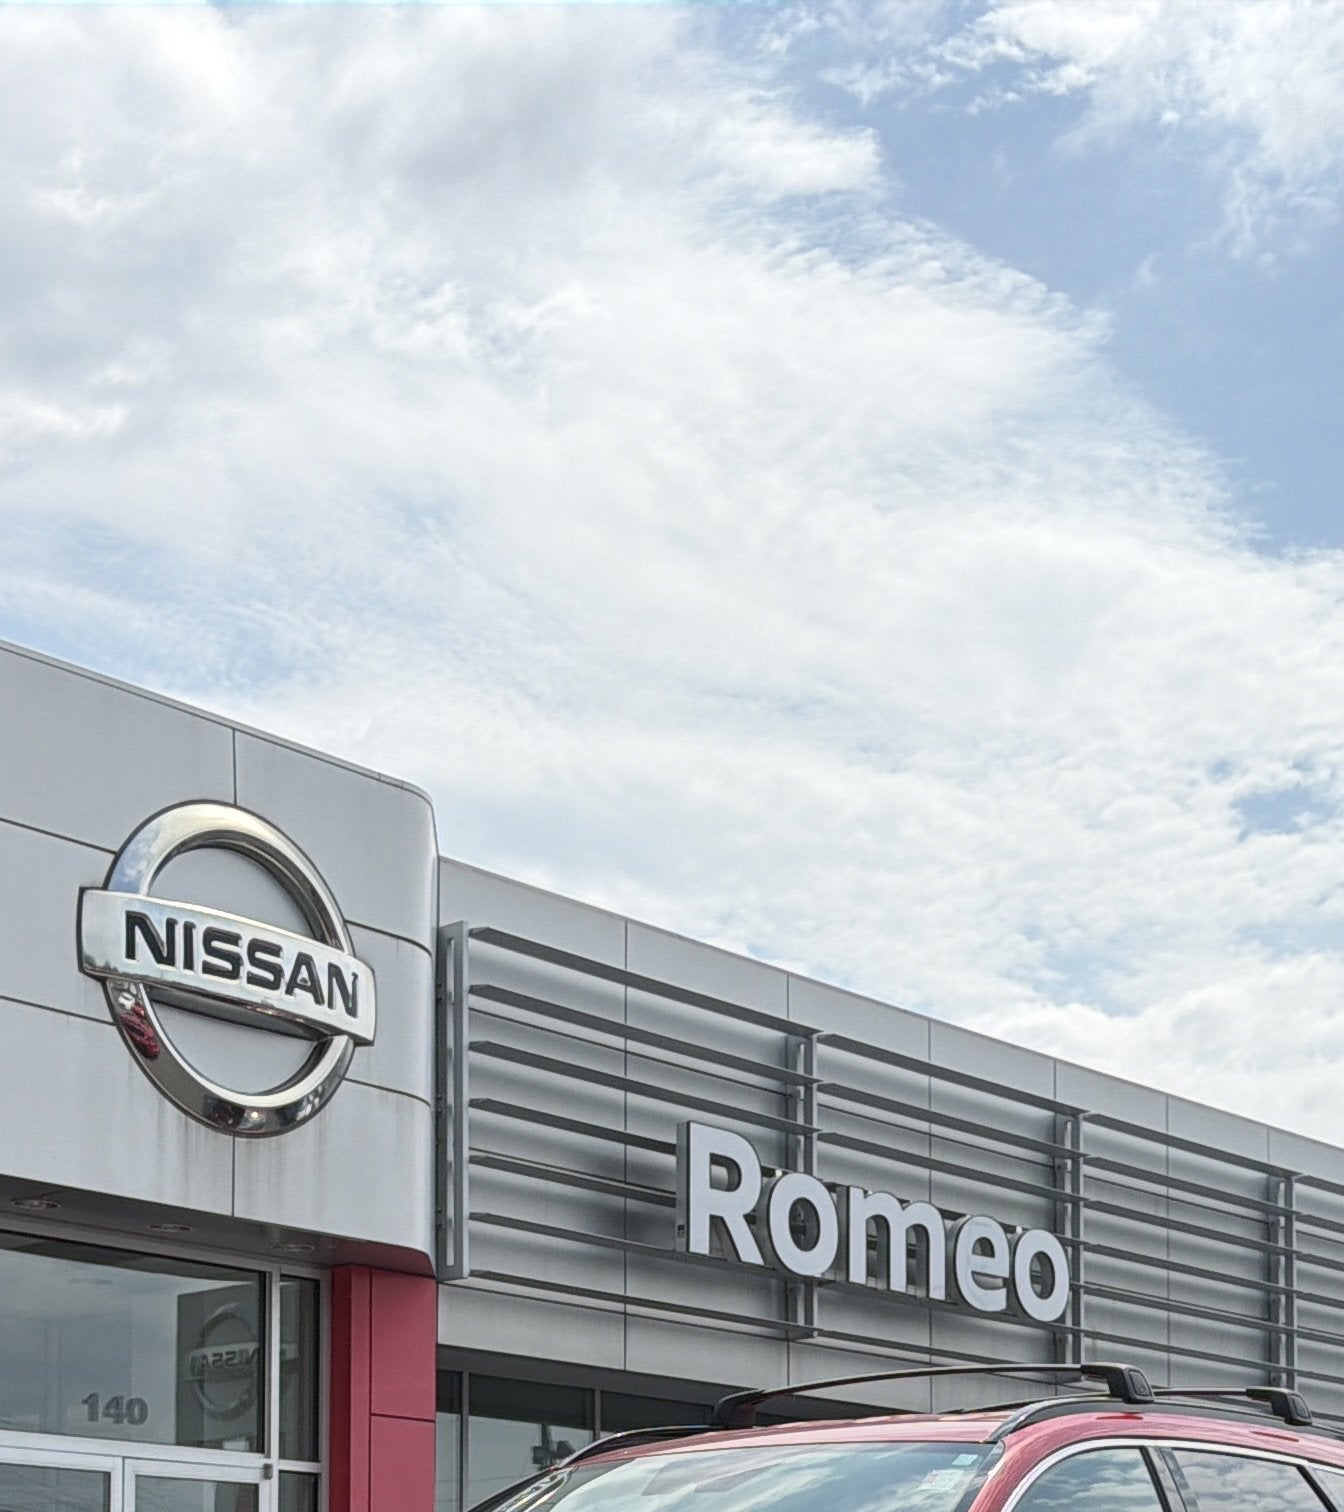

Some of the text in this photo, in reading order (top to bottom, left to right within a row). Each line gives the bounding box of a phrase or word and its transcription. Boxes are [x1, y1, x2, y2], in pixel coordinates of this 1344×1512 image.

[125, 909, 359, 1019] NISSAN
[678, 1120, 1071, 1323] Romeo
[81, 1393, 149, 1426] 140
